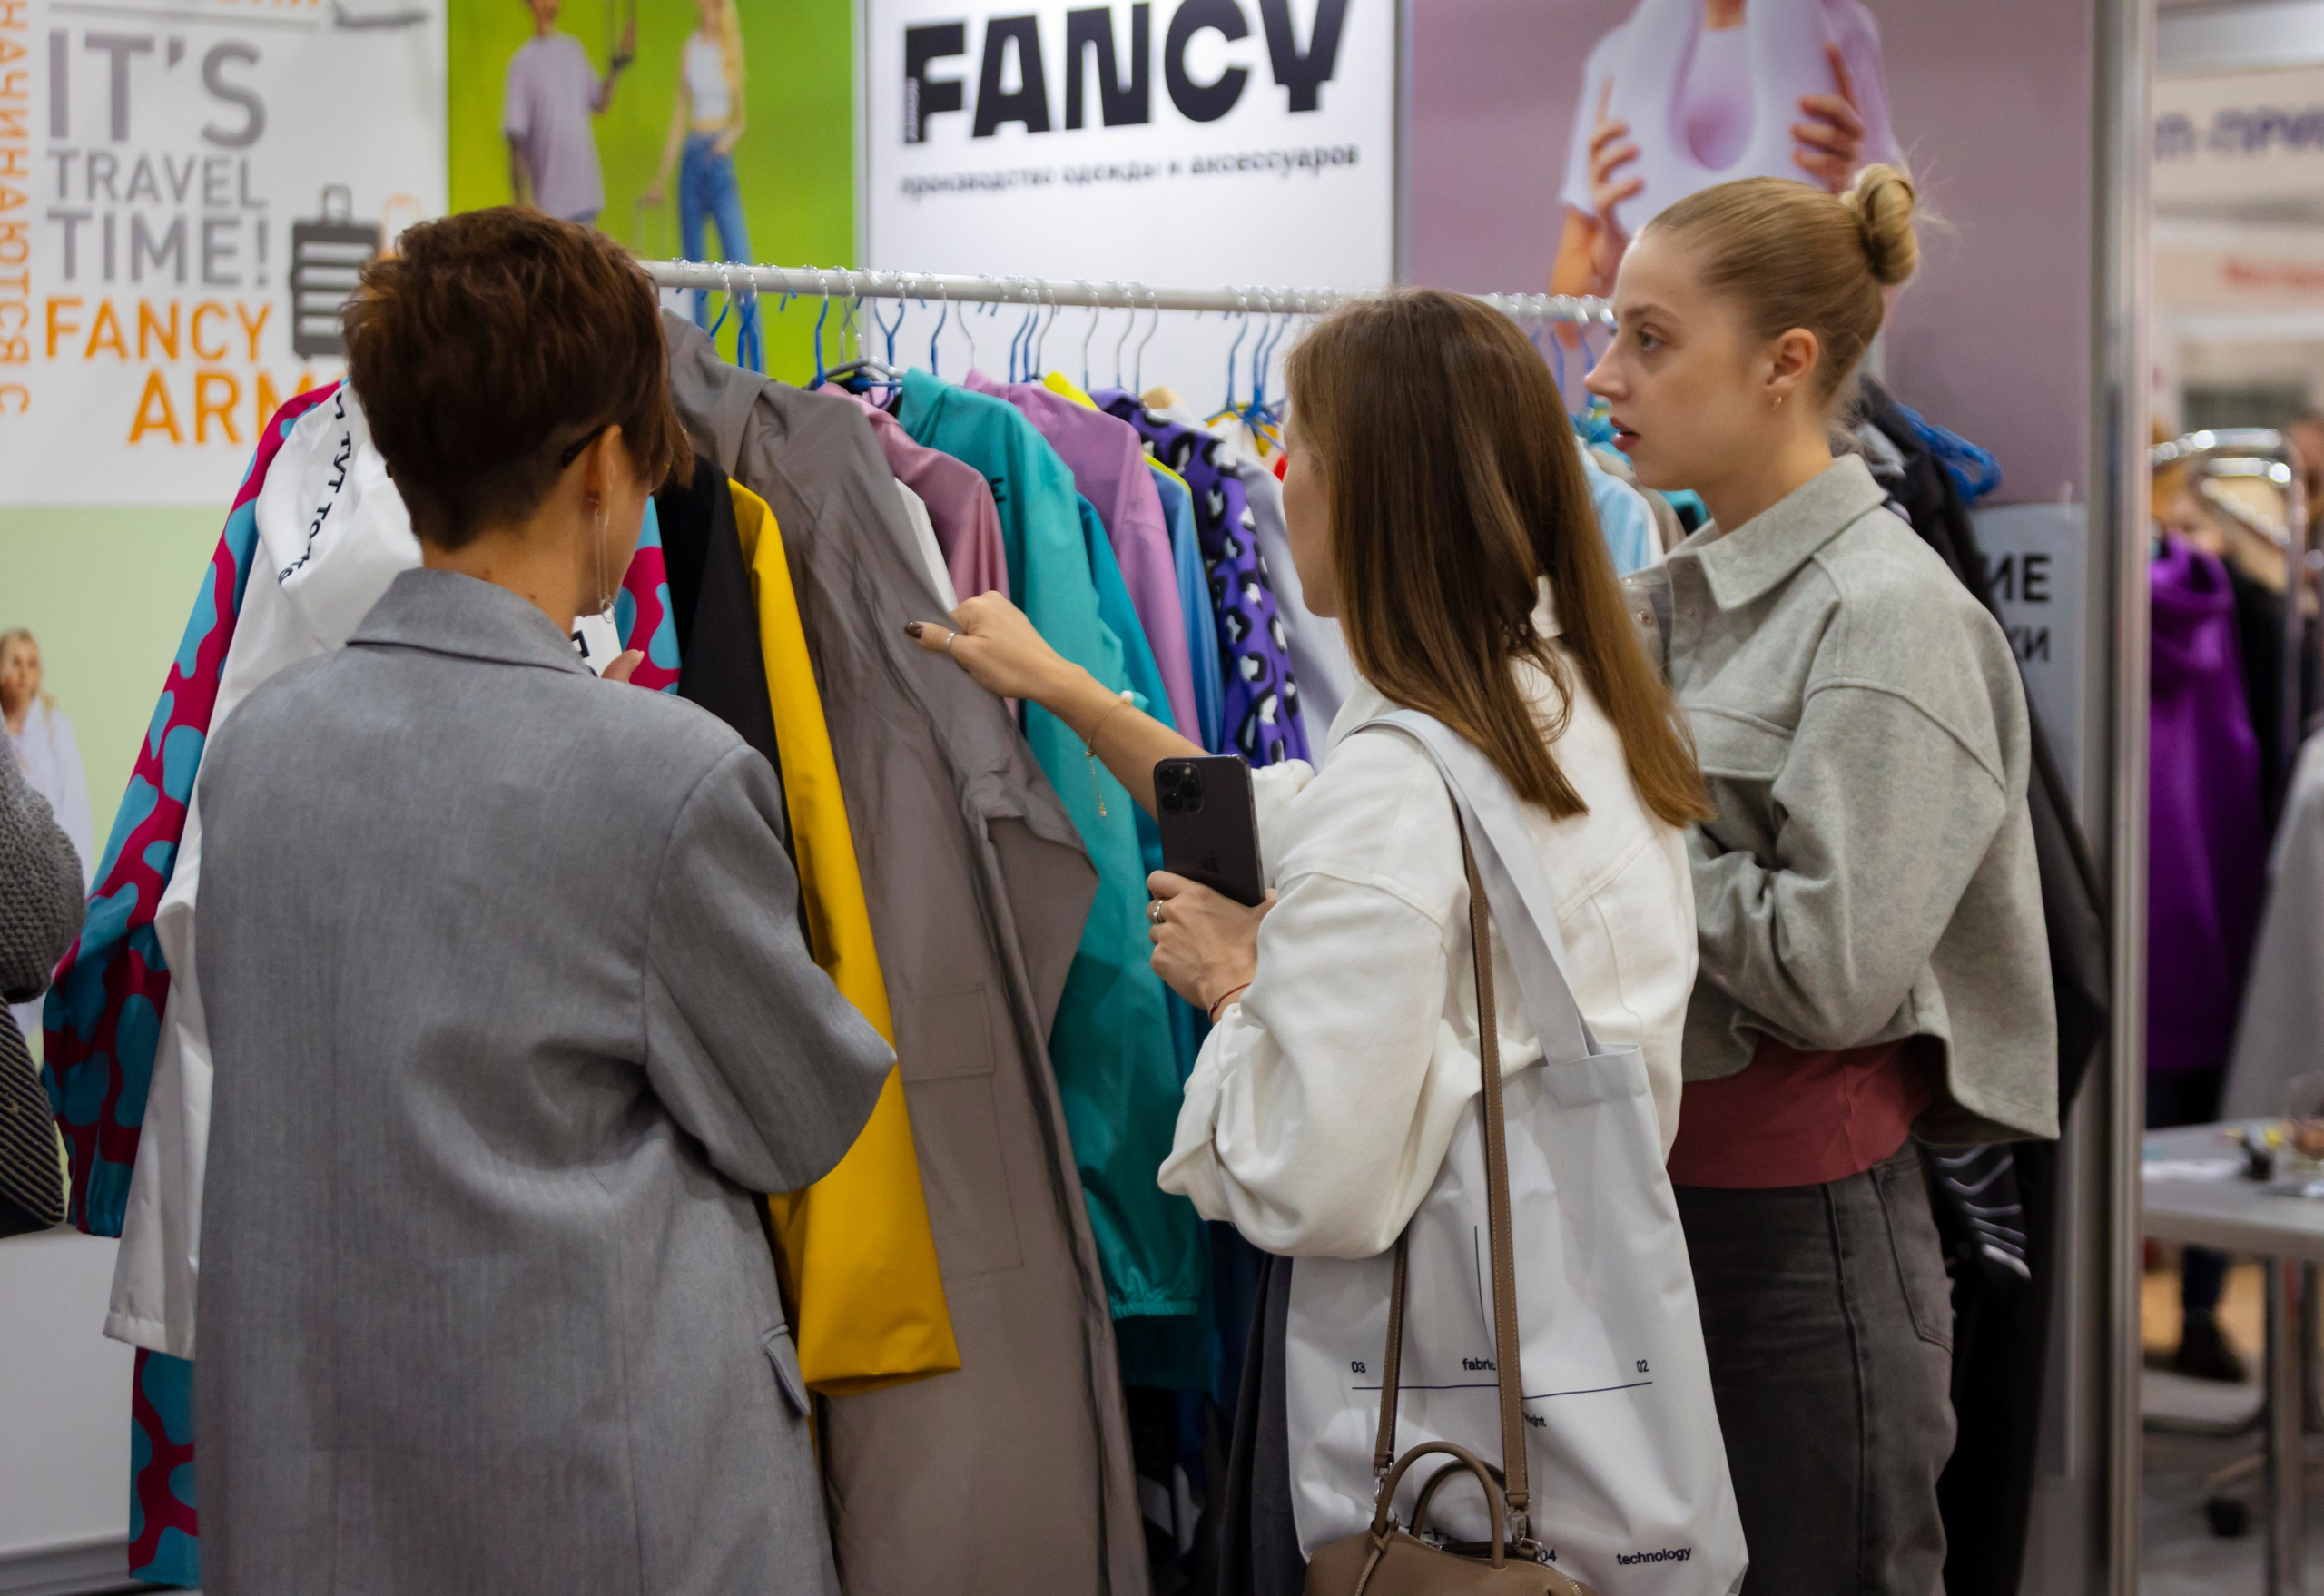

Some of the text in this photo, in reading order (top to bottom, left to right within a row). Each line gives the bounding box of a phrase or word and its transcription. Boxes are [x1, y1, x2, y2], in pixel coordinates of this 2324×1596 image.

[905, 0, 1350, 143] FANCY
[46, 147, 267, 208] TRAVEL
[1191, 144, 1359, 179] аксессуаров
[46, 210, 268, 287] TIME!
[45, 295, 274, 362] FANCY
[1351, 1361, 1366, 1373] 03
[1636, 1359, 1649, 1373] 02
[1616, 1547, 1692, 1565] technology
